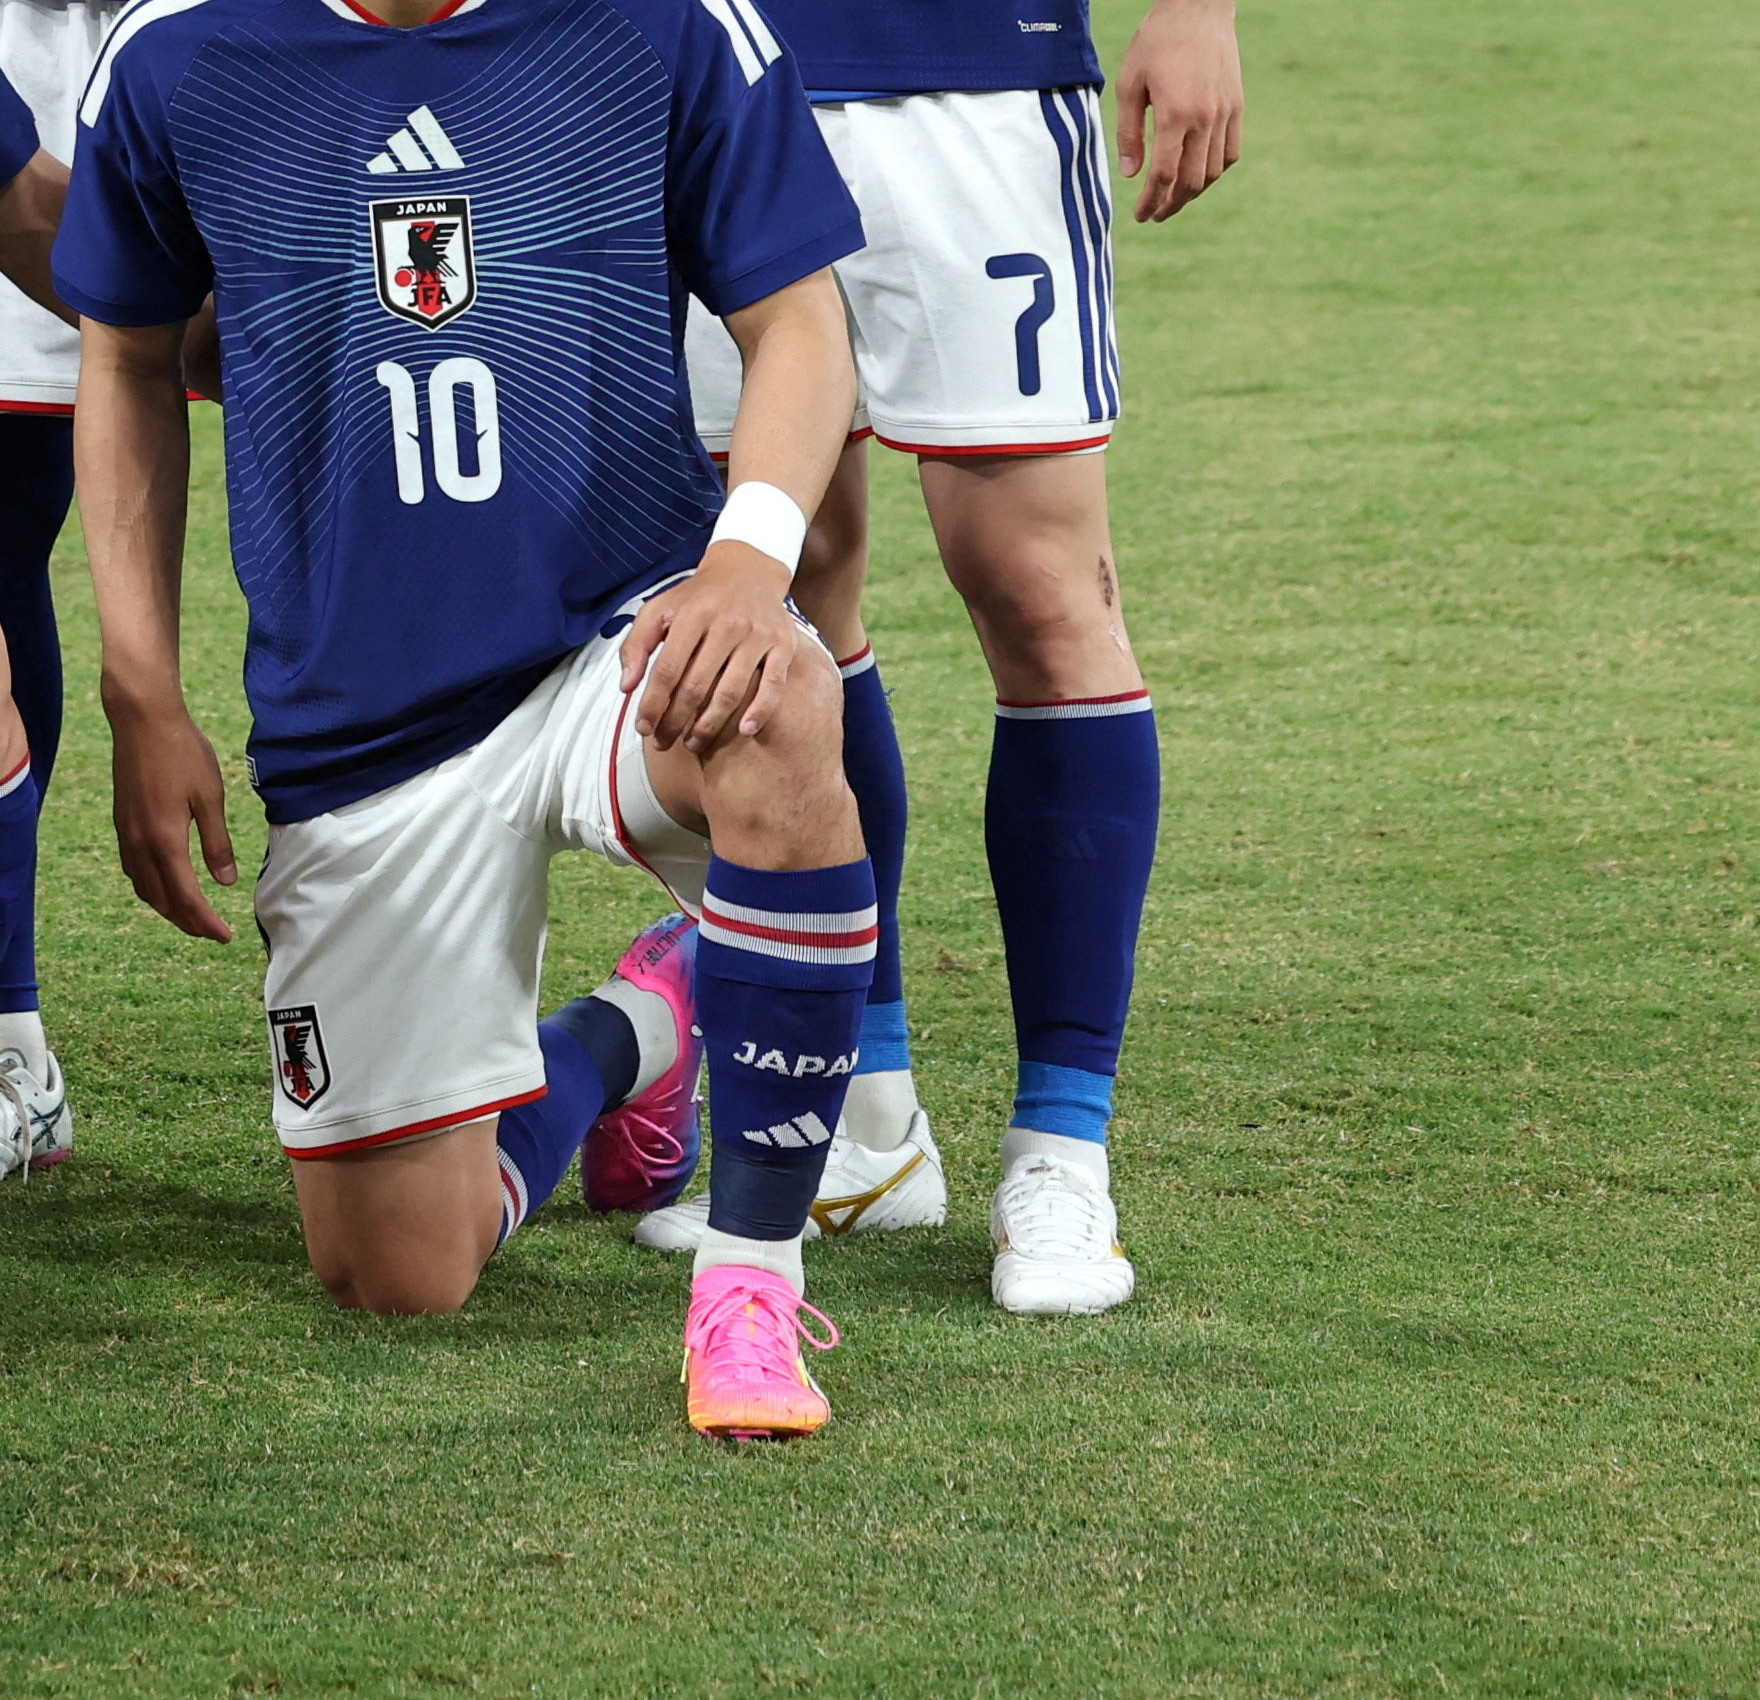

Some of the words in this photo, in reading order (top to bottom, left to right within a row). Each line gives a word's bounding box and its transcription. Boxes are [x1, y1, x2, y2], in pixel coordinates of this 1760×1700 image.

[396, 201, 447, 215] JAPAN
[408, 285, 453, 307] JFA
[985, 253, 1055, 396] 7
[376, 358, 503, 504] 10
[276, 1010, 302, 1021] JAPAN
